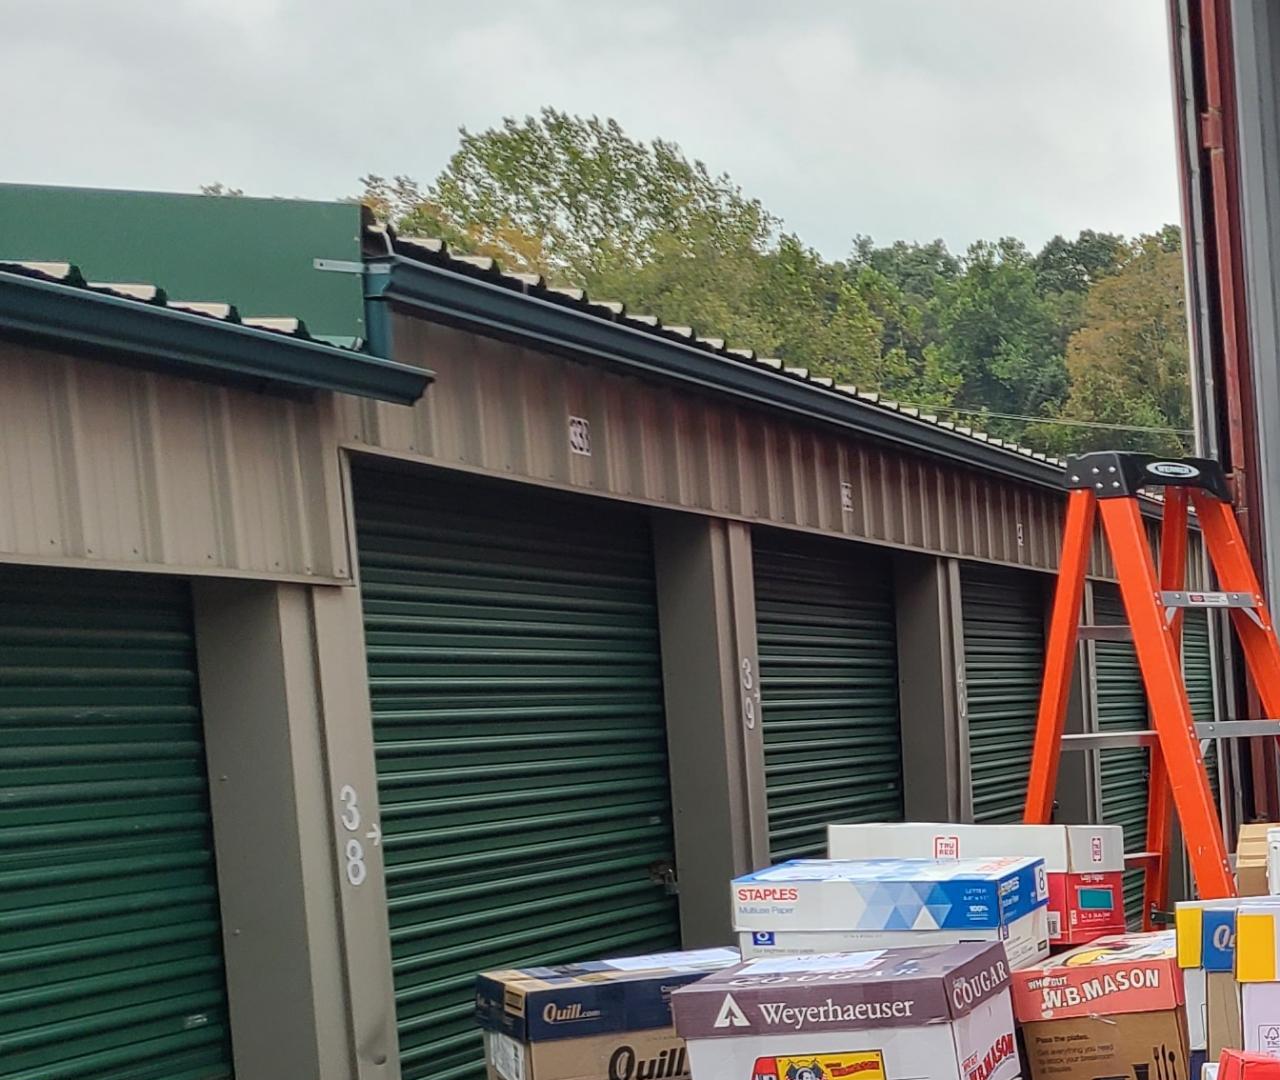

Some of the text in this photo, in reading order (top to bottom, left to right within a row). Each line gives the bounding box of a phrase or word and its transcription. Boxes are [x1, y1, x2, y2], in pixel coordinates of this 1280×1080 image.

[340, 785, 366, 886] 38
[738, 888, 798, 901] STAPLES
[771, 906, 794, 916] Paper
[953, 960, 1009, 1010] COUGAR
[1046, 968, 1160, 1010] W.B.MASON
[543, 1003, 600, 1024] Quill.com
[758, 999, 914, 1029] Weyerhaeuser
